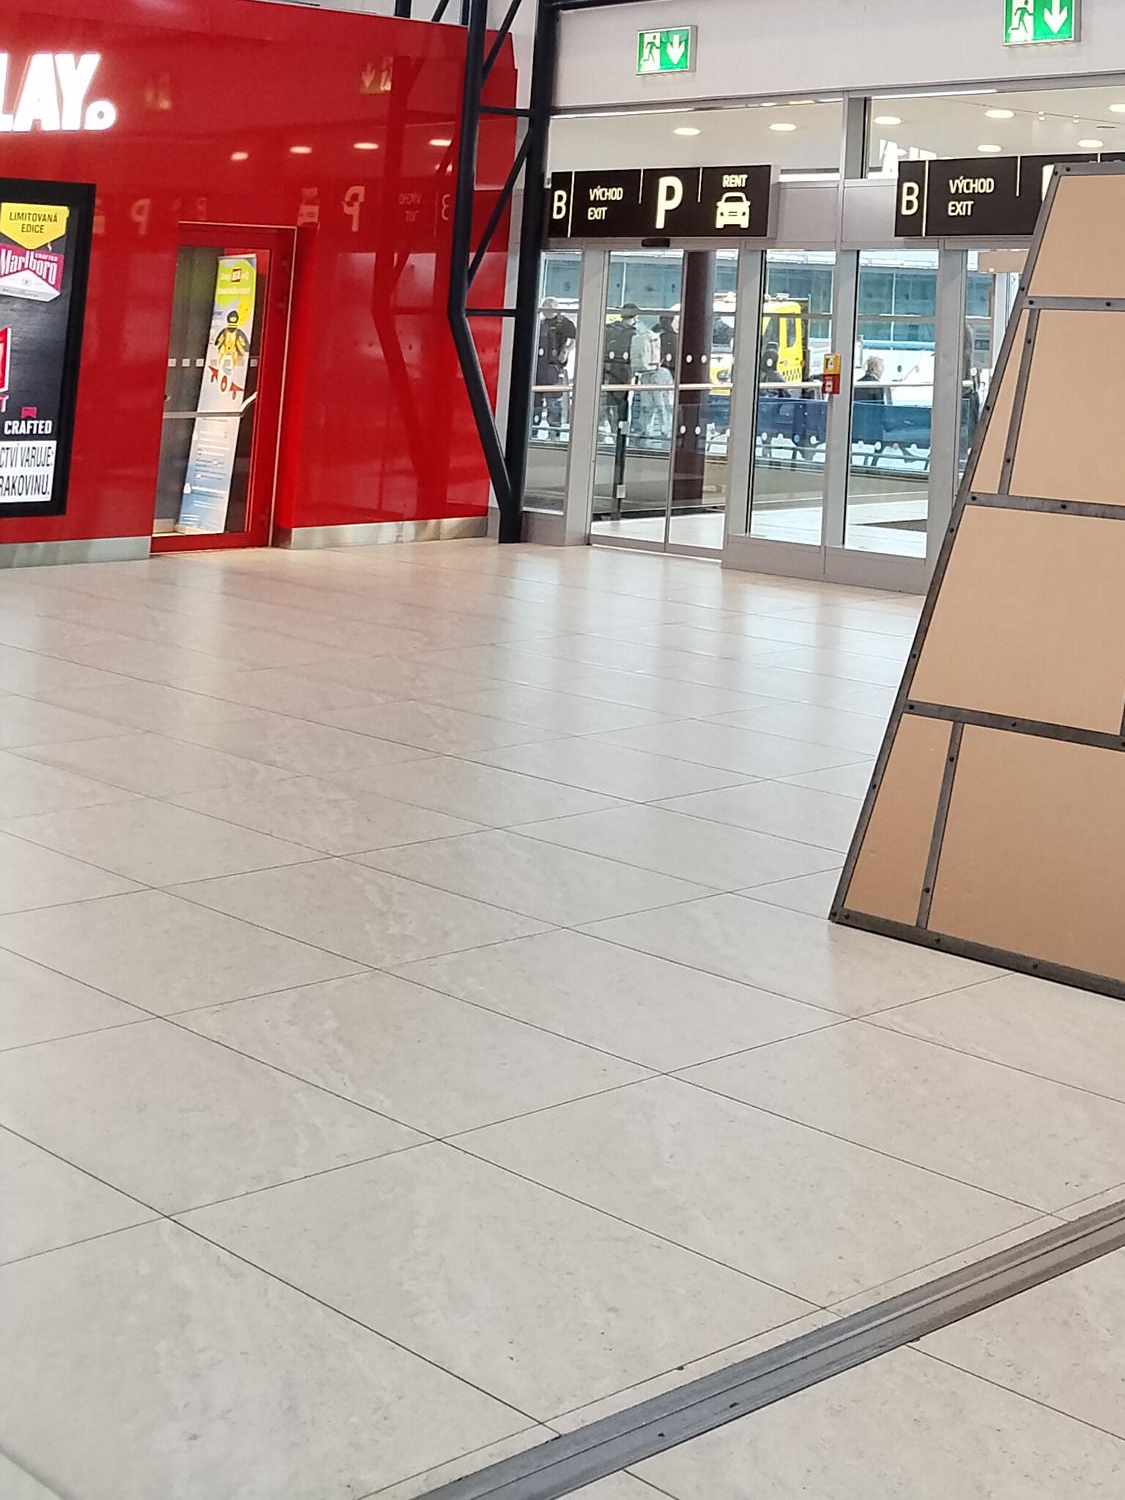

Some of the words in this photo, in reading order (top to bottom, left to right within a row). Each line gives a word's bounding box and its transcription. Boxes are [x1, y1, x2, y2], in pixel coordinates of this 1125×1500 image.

[722, 174, 748, 188] RENT
[948, 175, 995, 194] VÝCHOD
[589, 185, 624, 201] VÝCHOD
[900, 181, 920, 216] B
[552, 189, 568, 220] B
[654, 175, 684, 230] P
[947, 200, 974, 216] EXIT
[9, 211, 58, 222] LIMITOVANÁ
[587, 206, 608, 220] EXIT
[21, 223, 45, 234] EDICE
[3, 419, 53, 435] CRAFTED
[20, 446, 54, 468] VARUJE:
